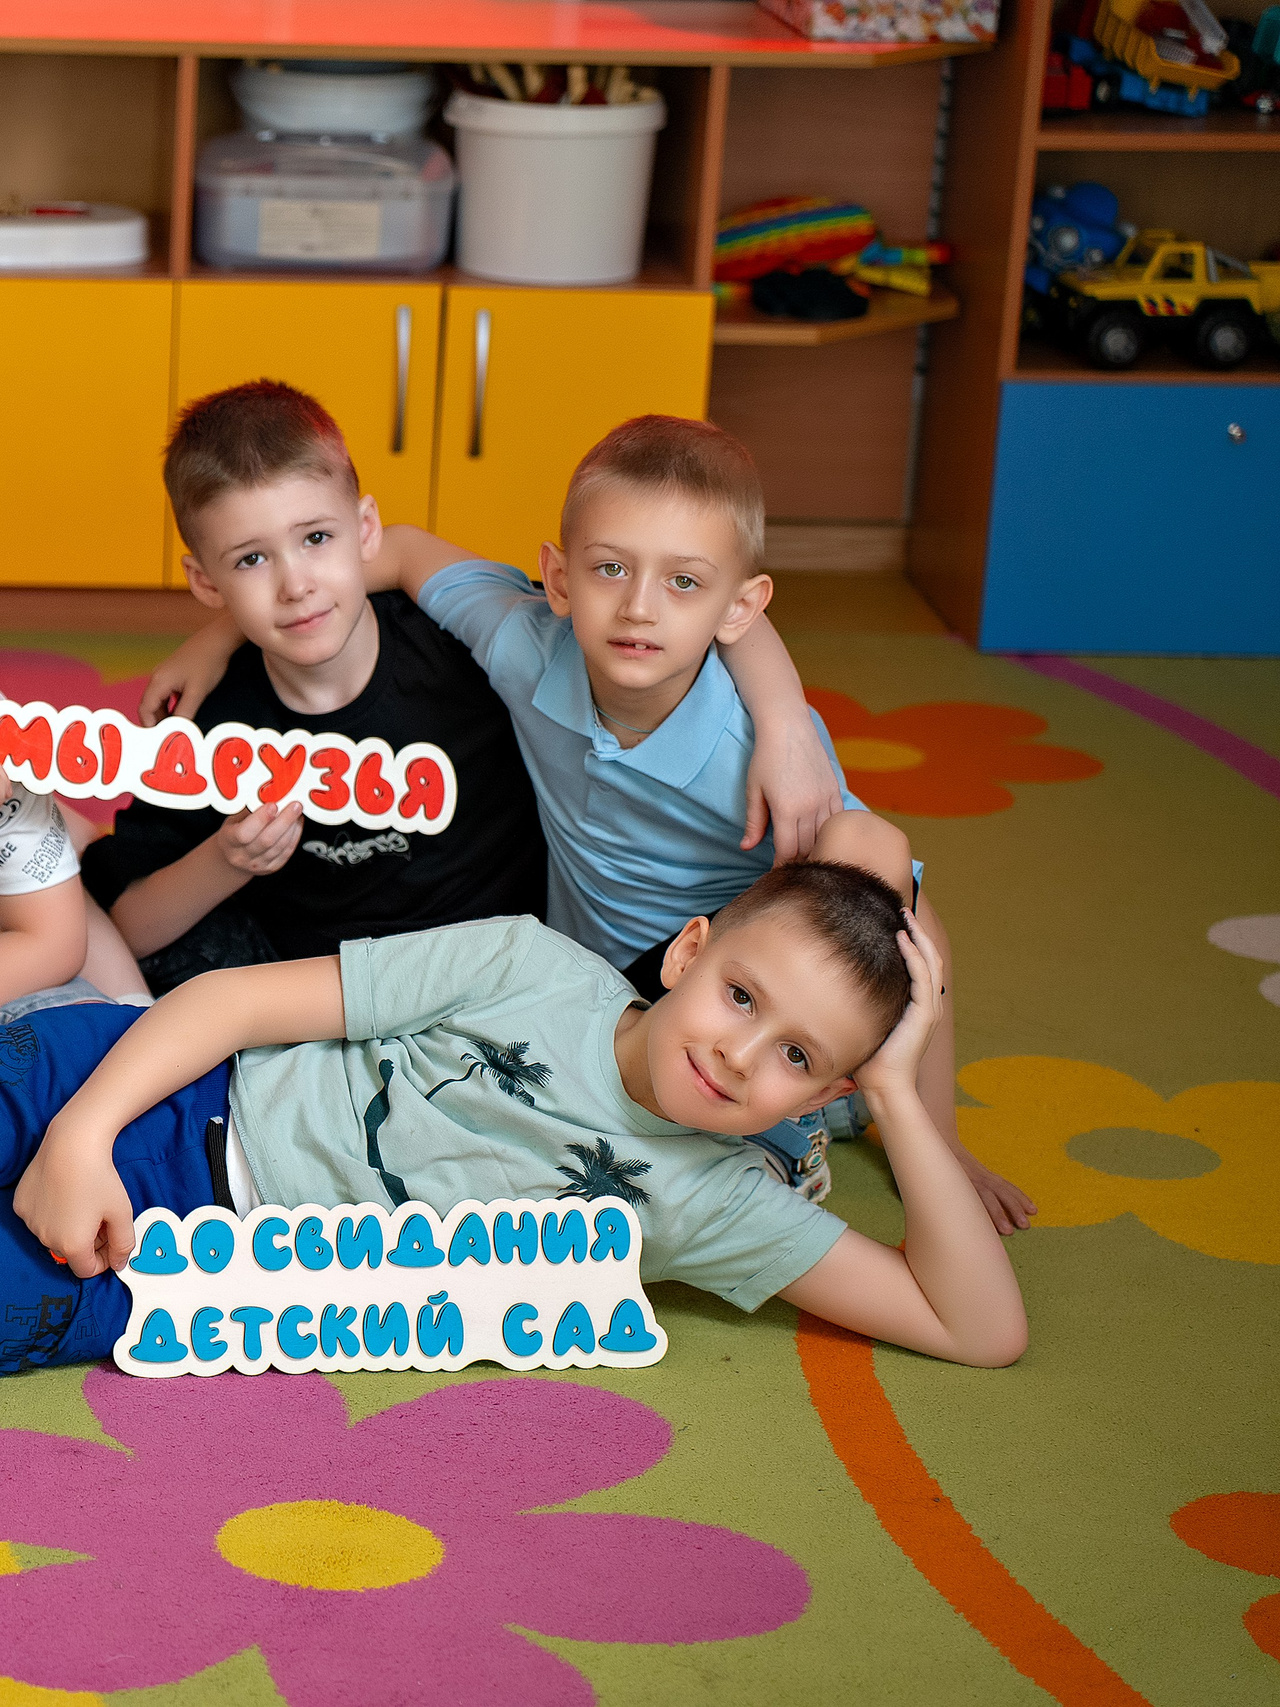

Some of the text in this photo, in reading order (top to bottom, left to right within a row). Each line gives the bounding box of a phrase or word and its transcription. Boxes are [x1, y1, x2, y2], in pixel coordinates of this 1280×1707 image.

[140, 731, 446, 821] ДРУЗЬЯ
[129, 1207, 631, 1275] ДО СВИДАНИЯ
[129, 1290, 465, 1363] ДЕТСКИЙ
[502, 1298, 658, 1358] САД
